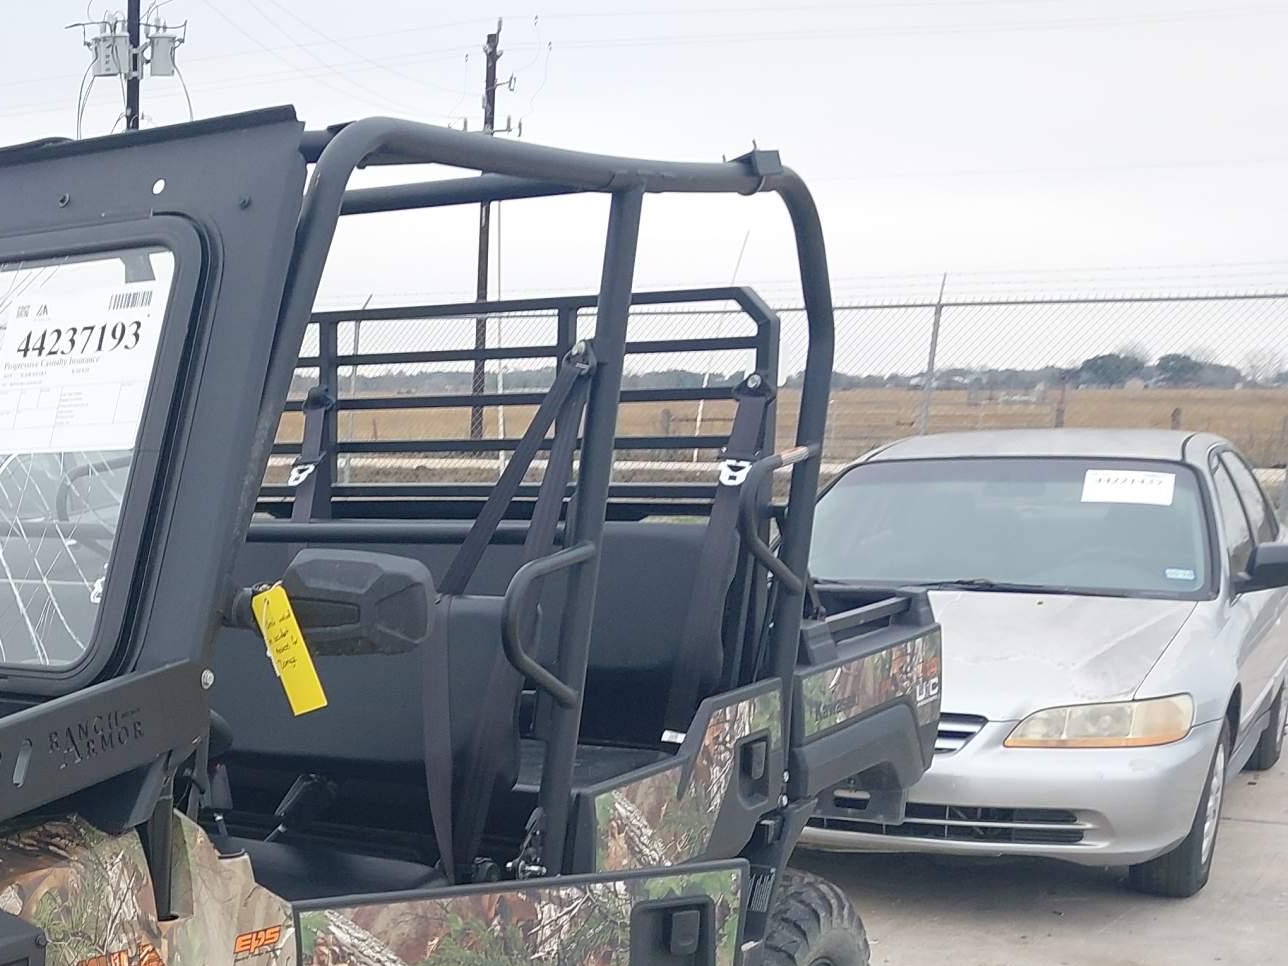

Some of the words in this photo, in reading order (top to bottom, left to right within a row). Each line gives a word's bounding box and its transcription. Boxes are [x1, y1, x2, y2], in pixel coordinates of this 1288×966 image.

[17, 320, 142, 358] 44237193
[48, 711, 119, 767] RANCH
[233, 925, 281, 954] EPS
